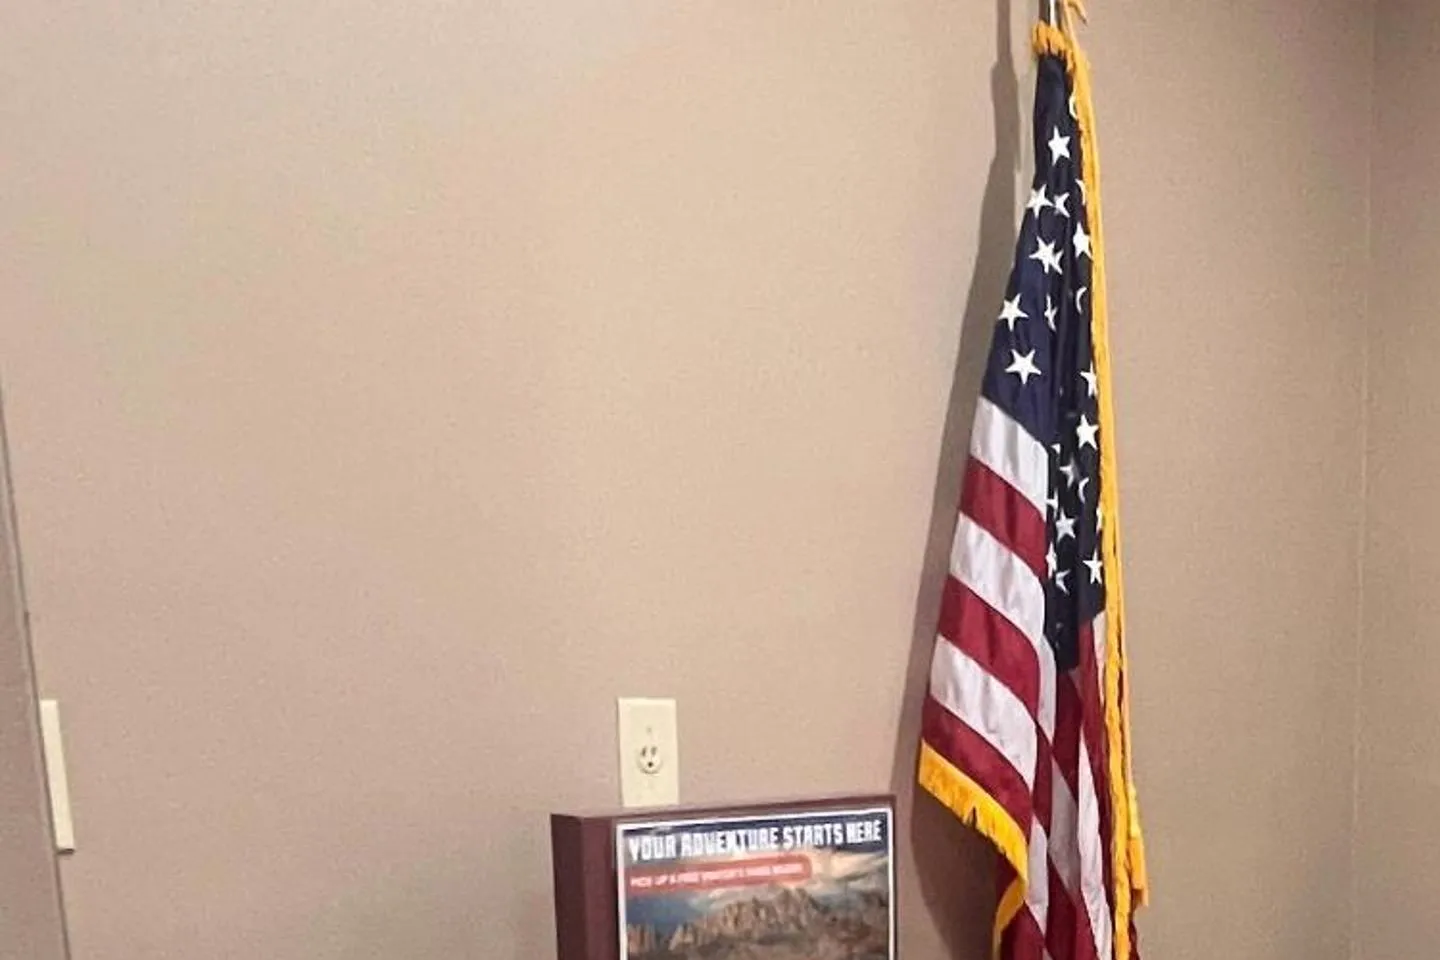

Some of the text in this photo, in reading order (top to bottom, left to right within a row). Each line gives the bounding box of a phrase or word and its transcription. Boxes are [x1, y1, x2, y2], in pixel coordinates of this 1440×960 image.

[628, 819, 882, 862] YOUR ADVENTURE STARTS HERE
